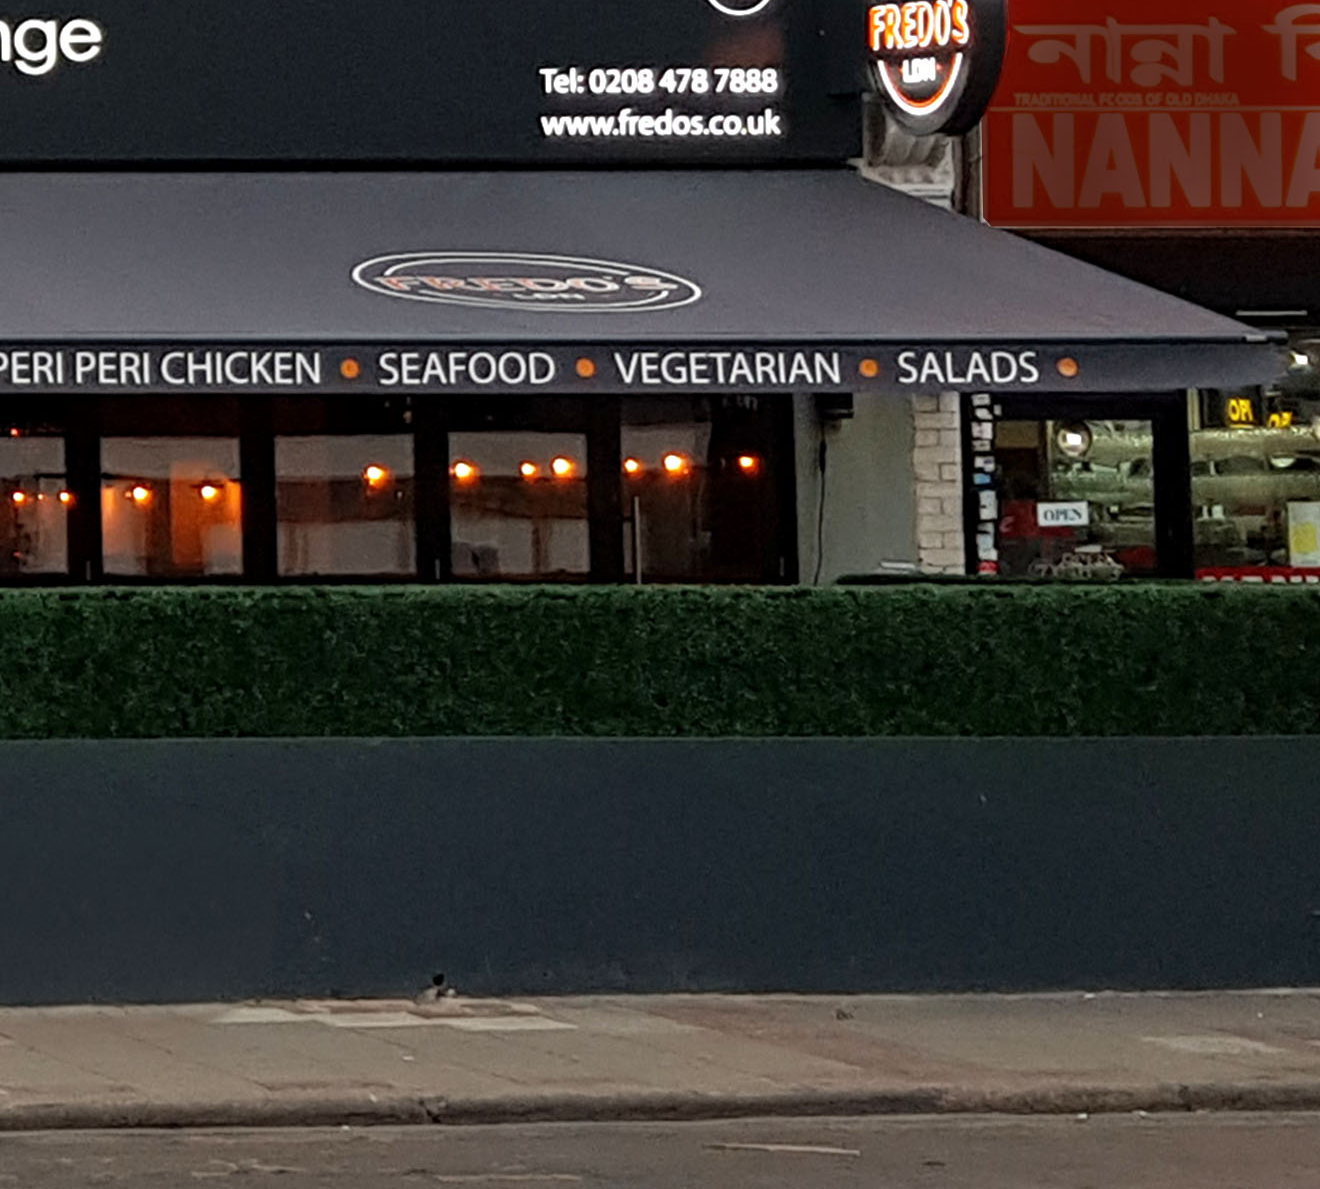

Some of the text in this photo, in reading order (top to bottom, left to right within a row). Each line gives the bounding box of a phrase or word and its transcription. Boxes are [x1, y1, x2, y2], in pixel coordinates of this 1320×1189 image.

[539, 68, 778, 94] Tel: 0208 478 7888
[902, 57, 937, 84] LDN
[1145, 92, 1164, 107] OF
[1165, 92, 1192, 107] OLD
[540, 108, 782, 136] www.fredos.co.uk
[374, 274, 678, 292] FREDO'S
[76, 352, 150, 384] PERI
[161, 351, 321, 384] CHICKEN
[379, 351, 555, 385] SEAFOOD
[614, 352, 841, 384] VEGETARIAN
[897, 351, 1039, 384] SALADS
[1043, 508, 1083, 523] OPEN
